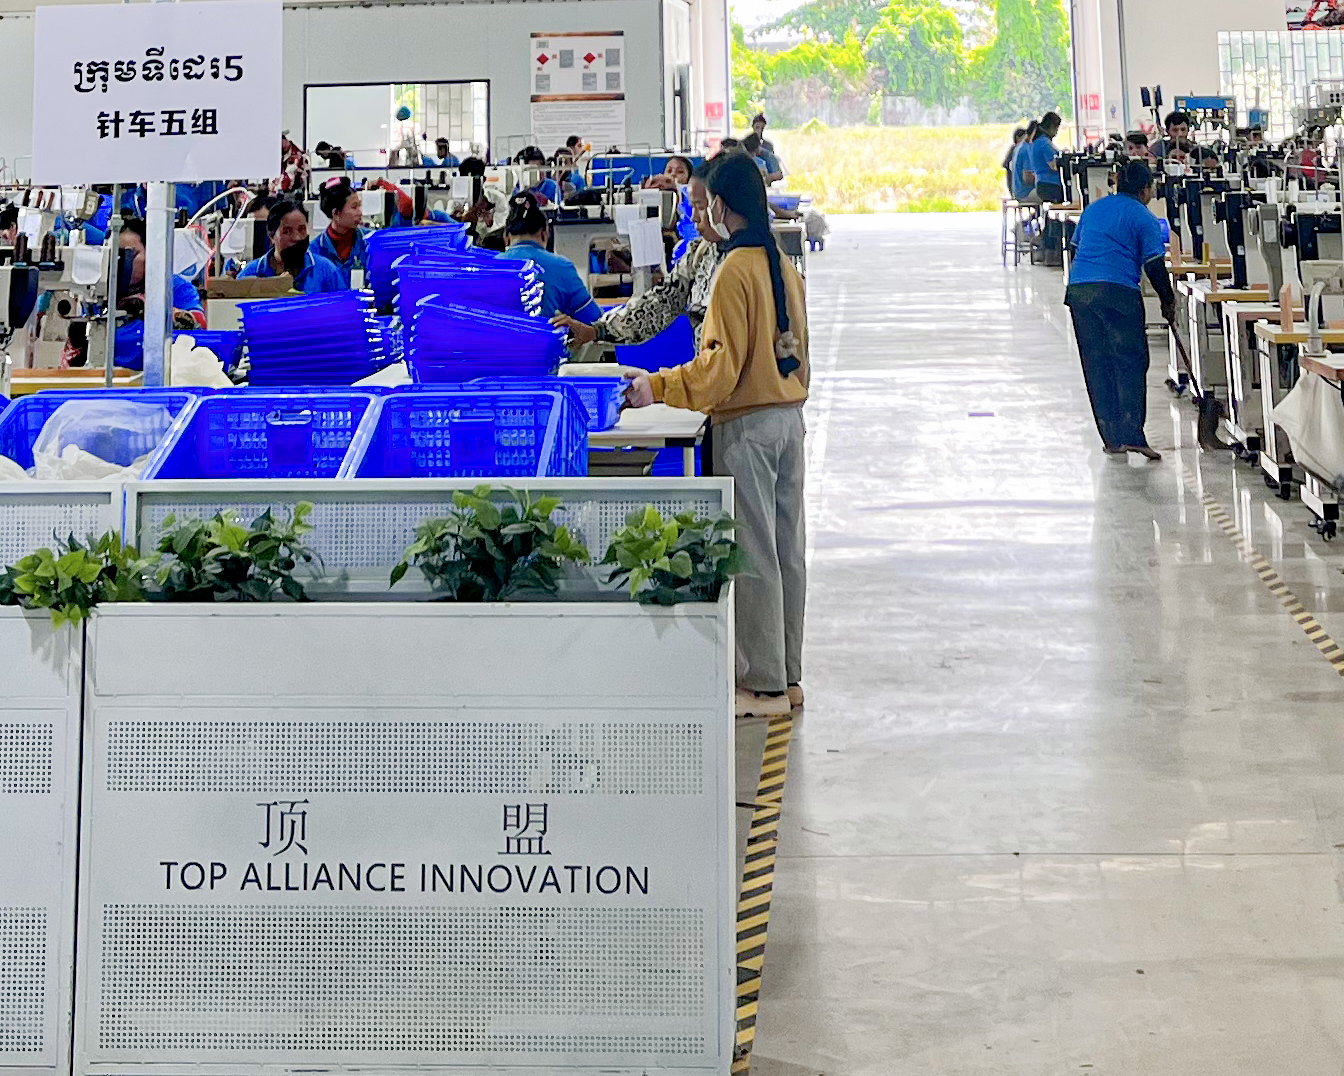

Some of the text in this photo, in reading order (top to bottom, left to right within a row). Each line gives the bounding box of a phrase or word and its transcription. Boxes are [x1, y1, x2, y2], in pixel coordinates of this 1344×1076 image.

[96, 107, 219, 140] 针车五组
[255, 798, 553, 857] 顶 盟
[159, 861, 649, 895] TOP ALLIANCE INNOVATION
